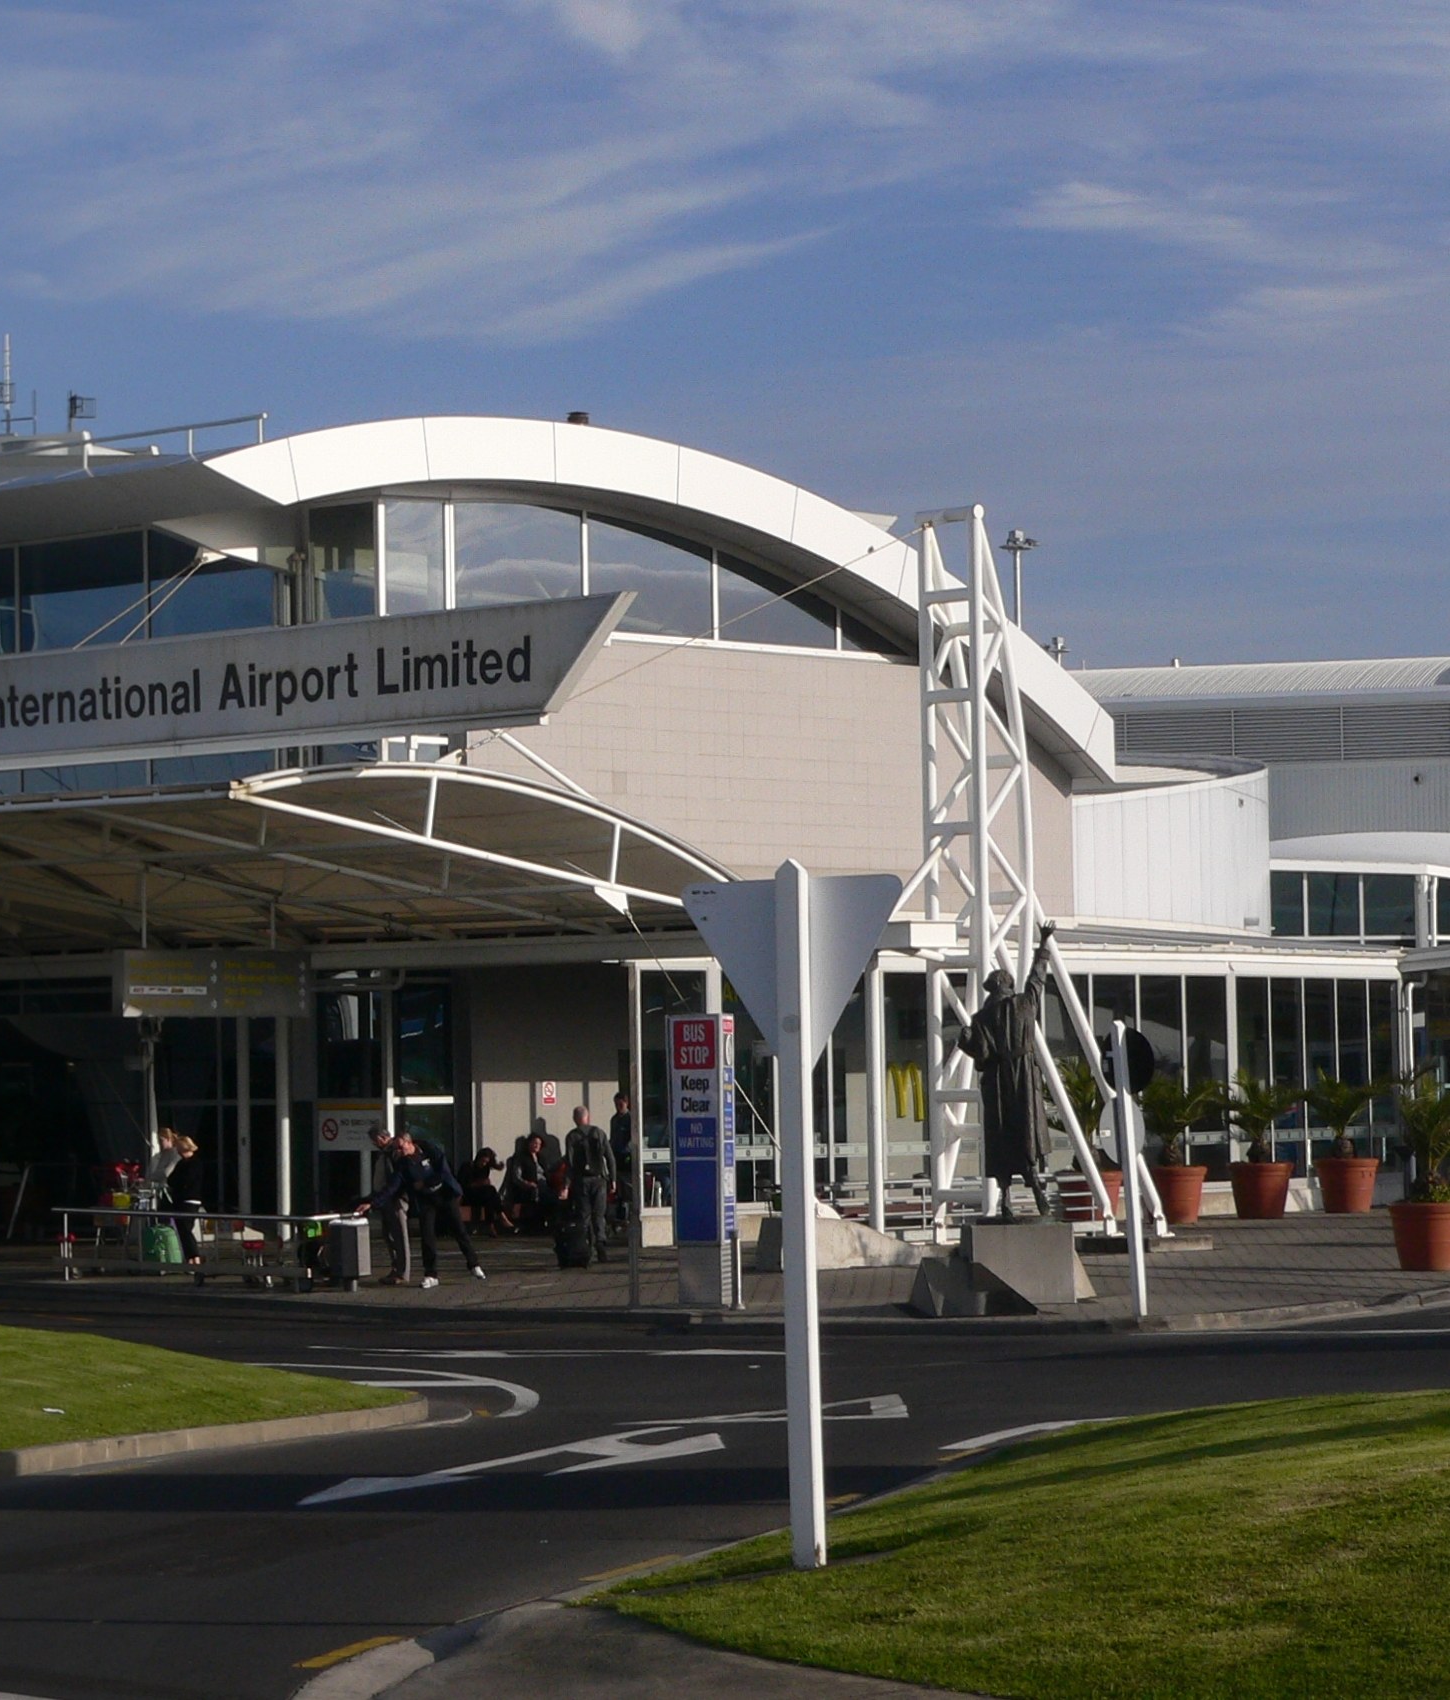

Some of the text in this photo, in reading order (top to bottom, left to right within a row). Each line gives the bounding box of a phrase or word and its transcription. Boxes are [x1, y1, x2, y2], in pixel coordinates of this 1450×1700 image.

[217, 652, 358, 716] Airport
[378, 635, 532, 696] Limited
[683, 1024, 705, 1042] BUS
[680, 1046, 710, 1065] STOP
[681, 1075, 710, 1094] Keep
[680, 1097, 710, 1113] Clear
[690, 1122, 703, 1135] NO
[678, 1137, 714, 1149] WAITING
